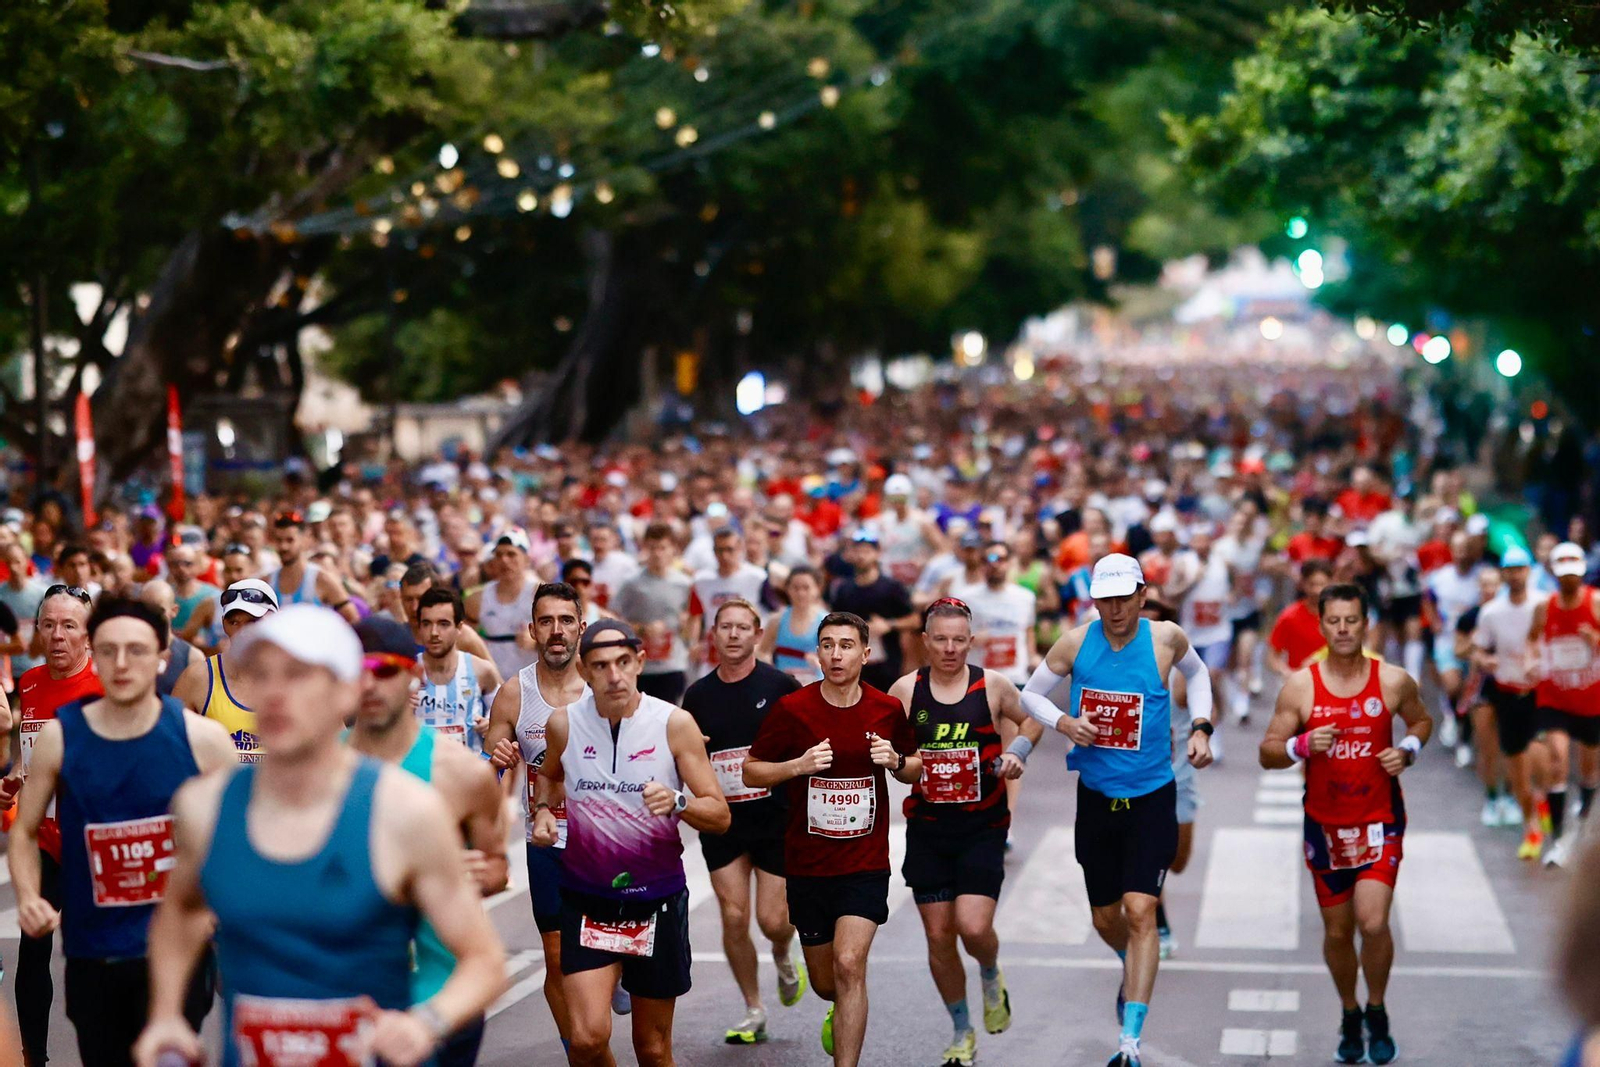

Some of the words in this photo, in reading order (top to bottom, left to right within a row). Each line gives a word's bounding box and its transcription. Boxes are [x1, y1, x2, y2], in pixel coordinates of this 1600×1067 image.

[1094, 693, 1133, 703] GENERALI
[931, 763, 961, 774] 2066
[826, 781, 866, 790] GENERALI
[821, 793, 860, 805] 14990
[109, 840, 155, 861] 1105
